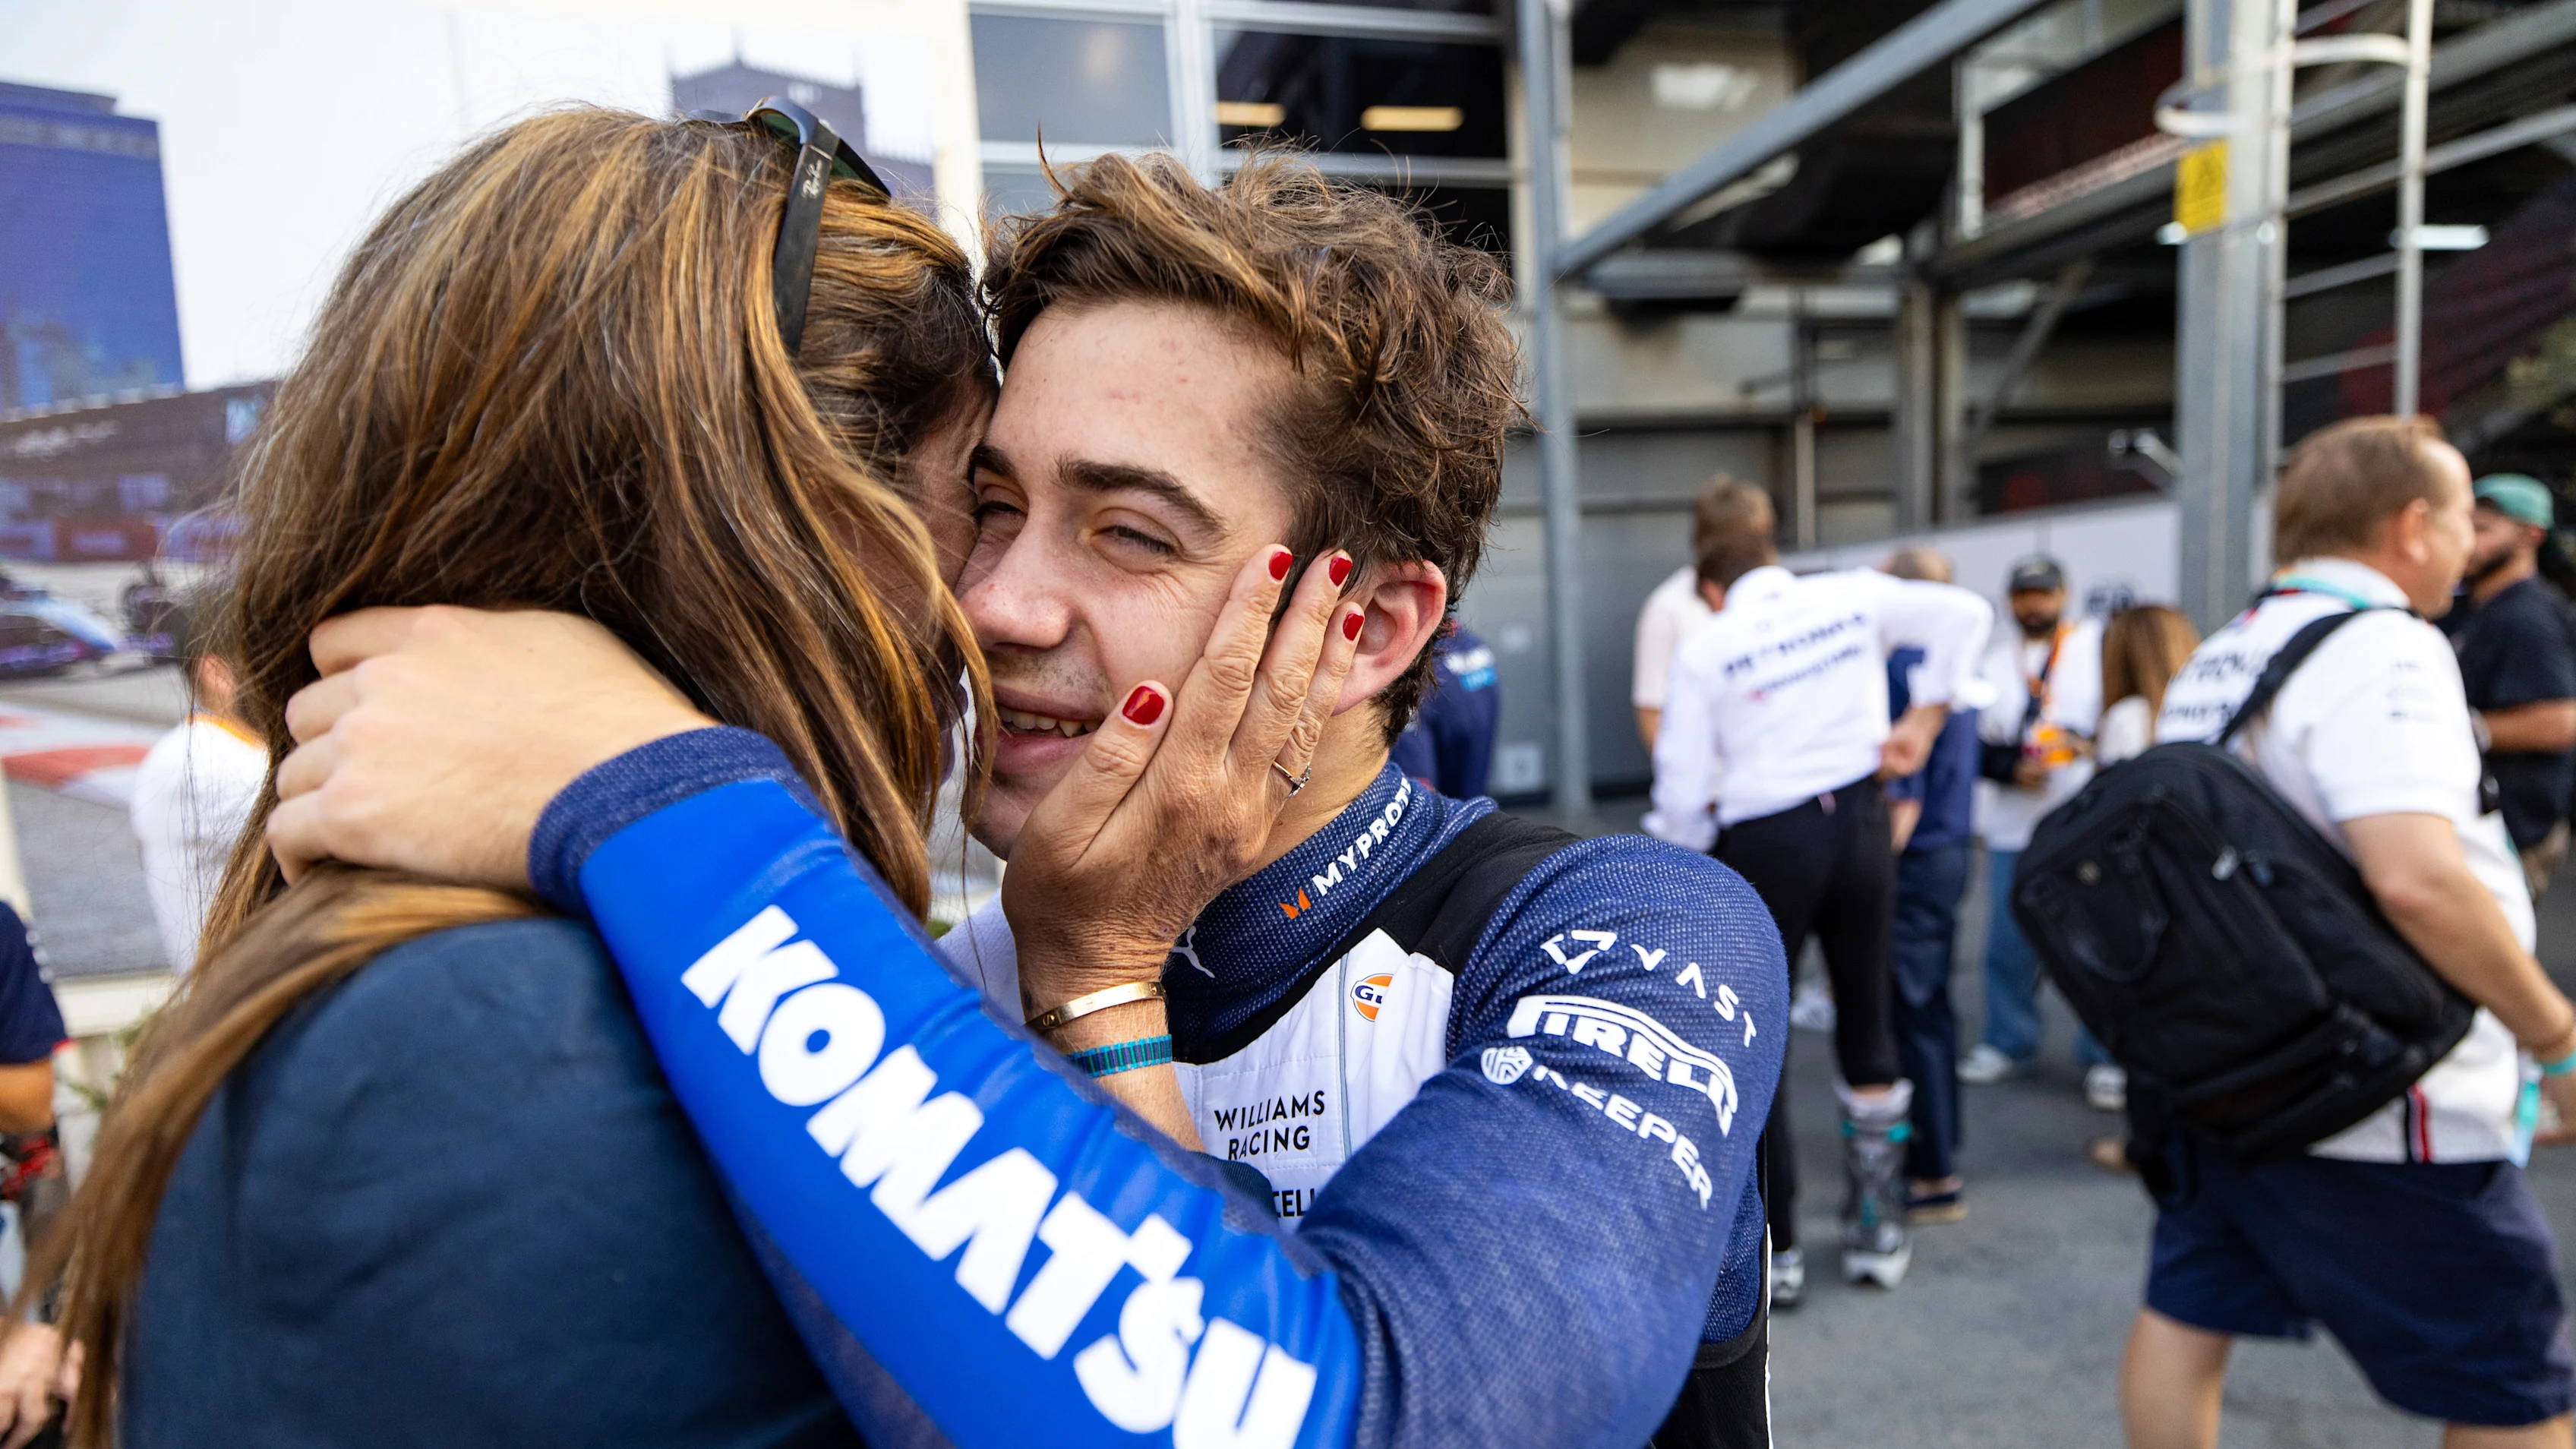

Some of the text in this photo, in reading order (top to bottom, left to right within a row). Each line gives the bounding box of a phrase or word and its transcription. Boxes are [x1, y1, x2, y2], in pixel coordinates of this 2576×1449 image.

[1630, 943, 1757, 1048] VAST
[1214, 1090, 1325, 1132] WILLIAMS
[1227, 1125, 1311, 1161] RACING
[1532, 1064, 1713, 1211] KEEPER
[680, 904, 1318, 1449] KOMATSU
